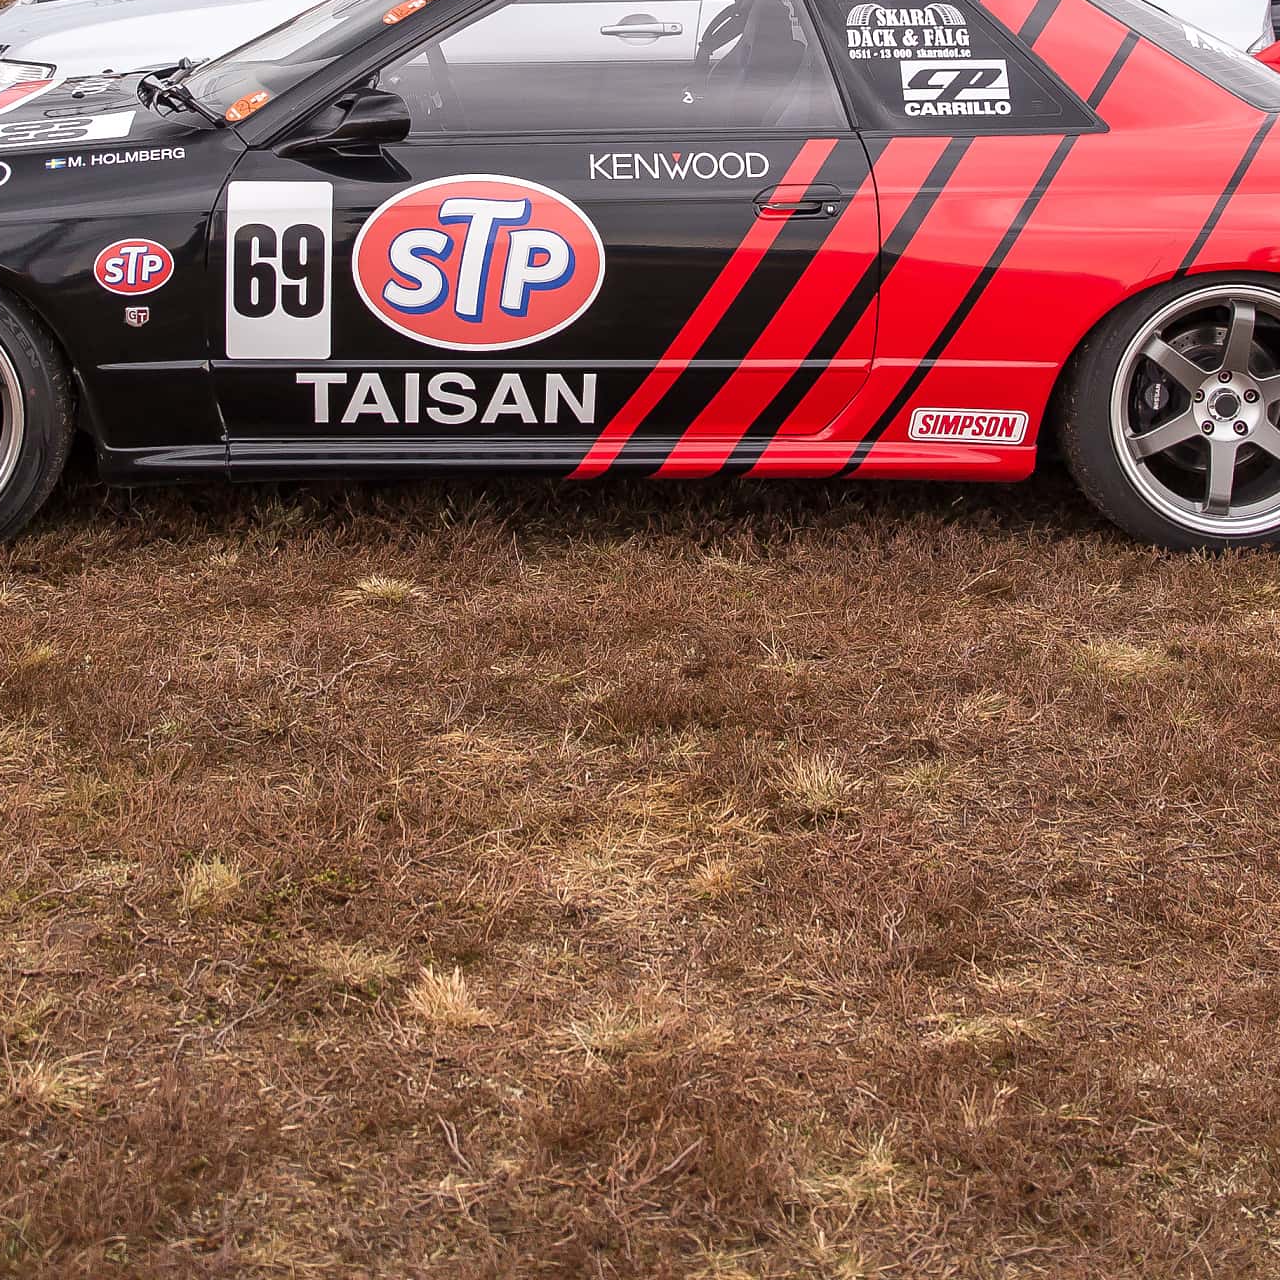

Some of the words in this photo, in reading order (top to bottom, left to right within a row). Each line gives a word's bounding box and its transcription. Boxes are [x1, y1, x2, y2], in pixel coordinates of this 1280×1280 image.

[875, 8, 938, 26] SKARA
[846, 26, 898, 48] DÄCK
[902, 29, 919, 47] &
[922, 26, 970, 47] FÄLG
[849, 49, 872, 60] 0511
[880, 49, 892, 59] 13
[893, 49, 912, 59] 000
[904, 101, 1012, 116] CARRILLO
[68, 155, 86, 168] M.
[91, 147, 186, 166] HOLMBERG
[590, 151, 770, 180] KENWOOD
[104, 245, 164, 285] STP
[233, 223, 325, 318] 69
[382, 198, 576, 323] STP
[128, 309, 147, 324] GT
[296, 371, 598, 424] TAISAN
[918, 413, 1017, 438] SIMPSON
